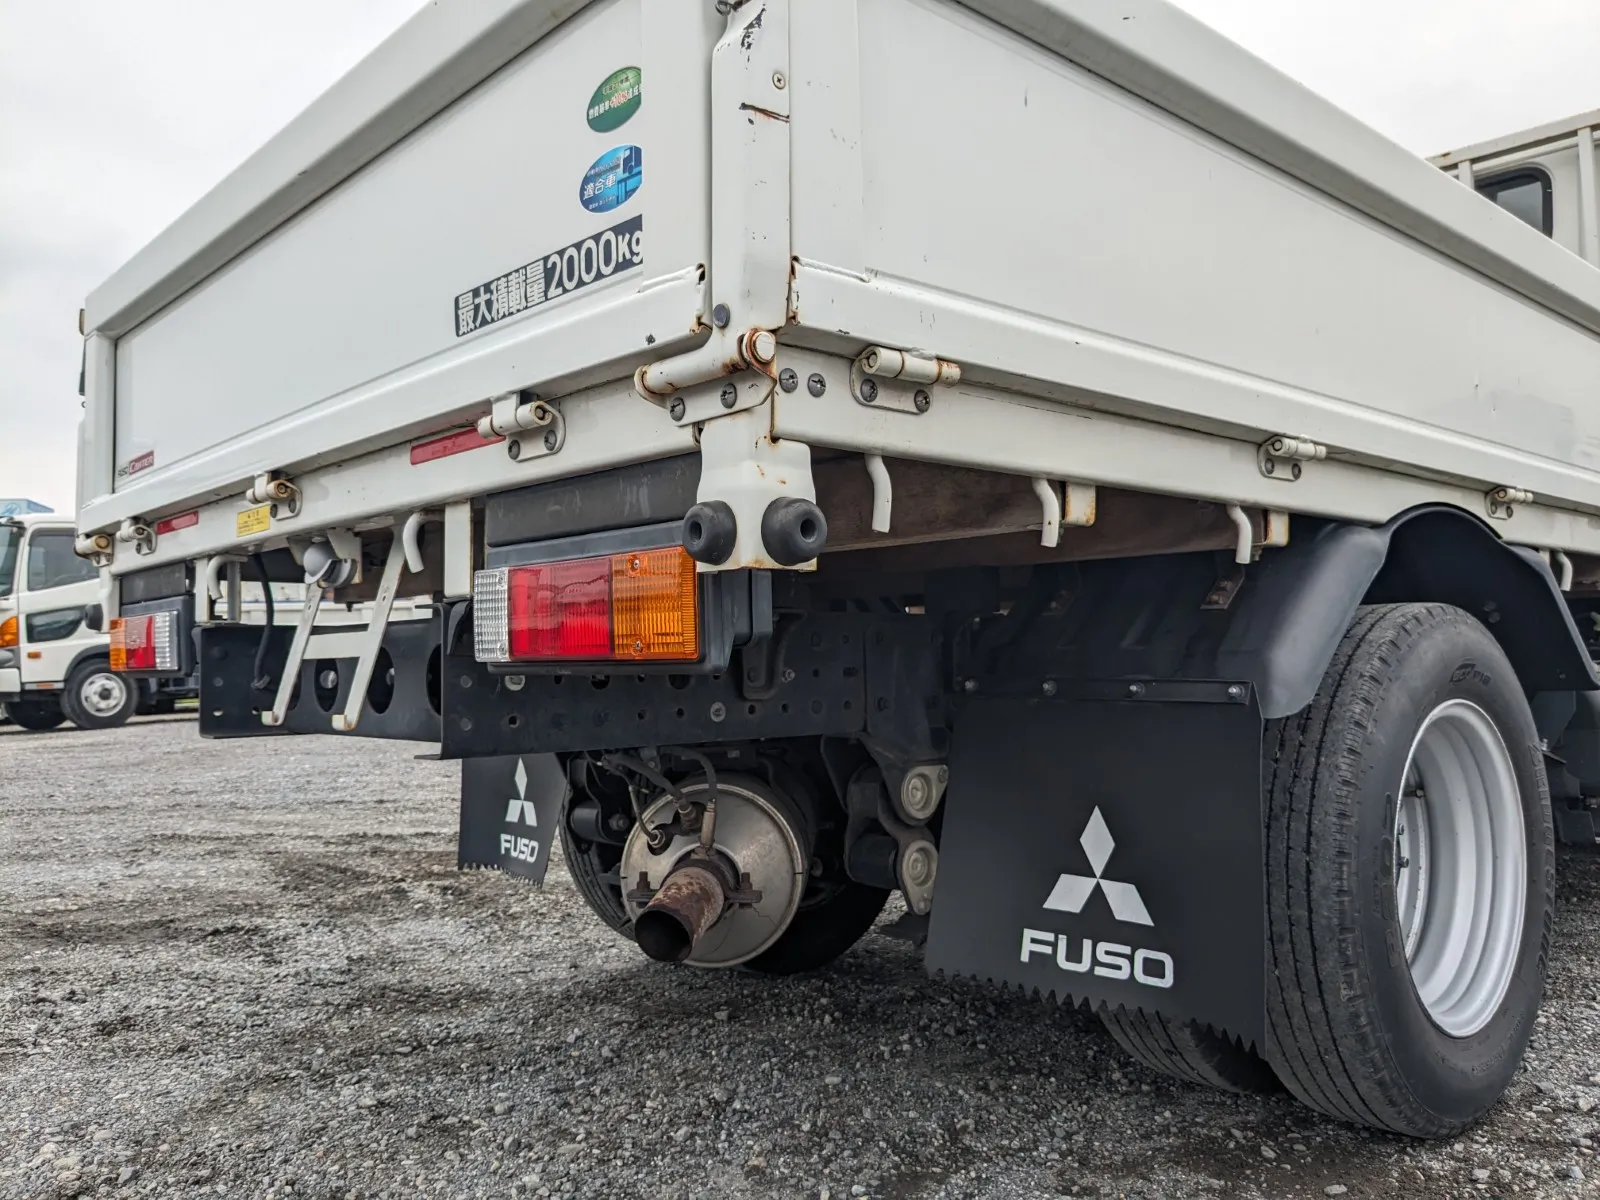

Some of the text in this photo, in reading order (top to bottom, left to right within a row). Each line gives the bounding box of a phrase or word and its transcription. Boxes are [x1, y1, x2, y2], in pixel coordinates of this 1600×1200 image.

[583, 172, 617, 201] 適合車
[500, 833, 539, 864] FUSO
[1020, 928, 1175, 989] FUSO
